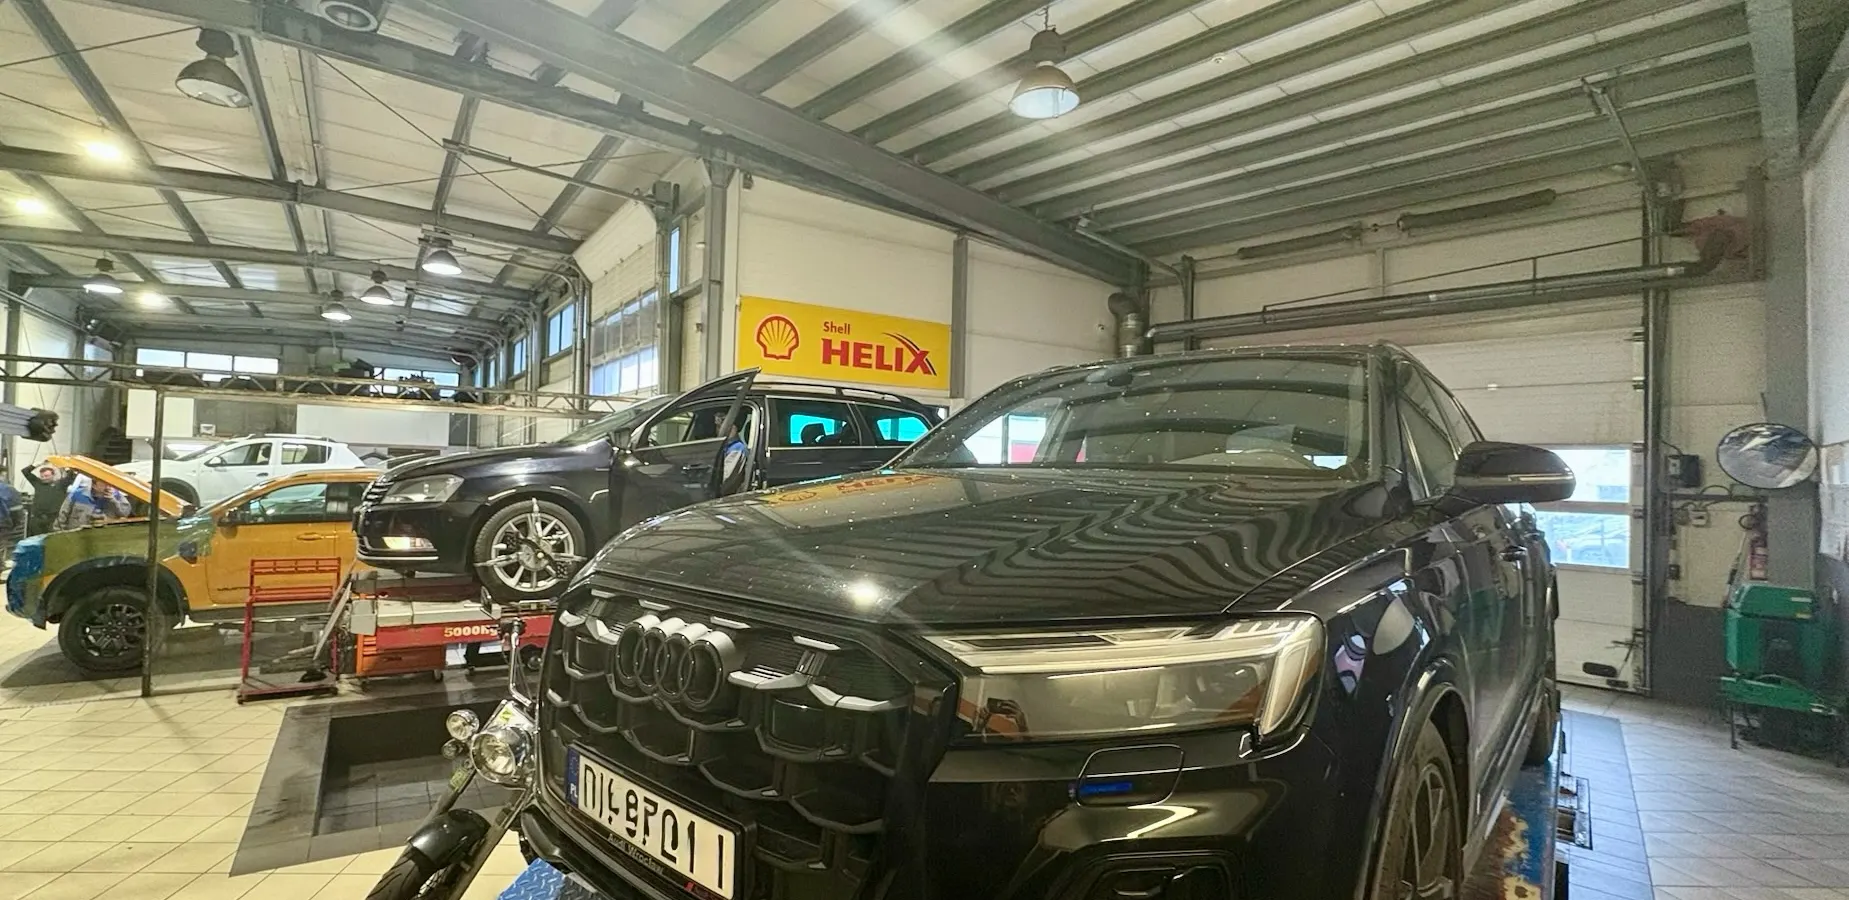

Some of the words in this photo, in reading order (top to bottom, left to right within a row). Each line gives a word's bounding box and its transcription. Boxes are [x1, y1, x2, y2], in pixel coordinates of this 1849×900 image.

[823, 321, 851, 335] Shell
[821, 333, 936, 376] HELIX
[570, 782, 578, 798] PL
